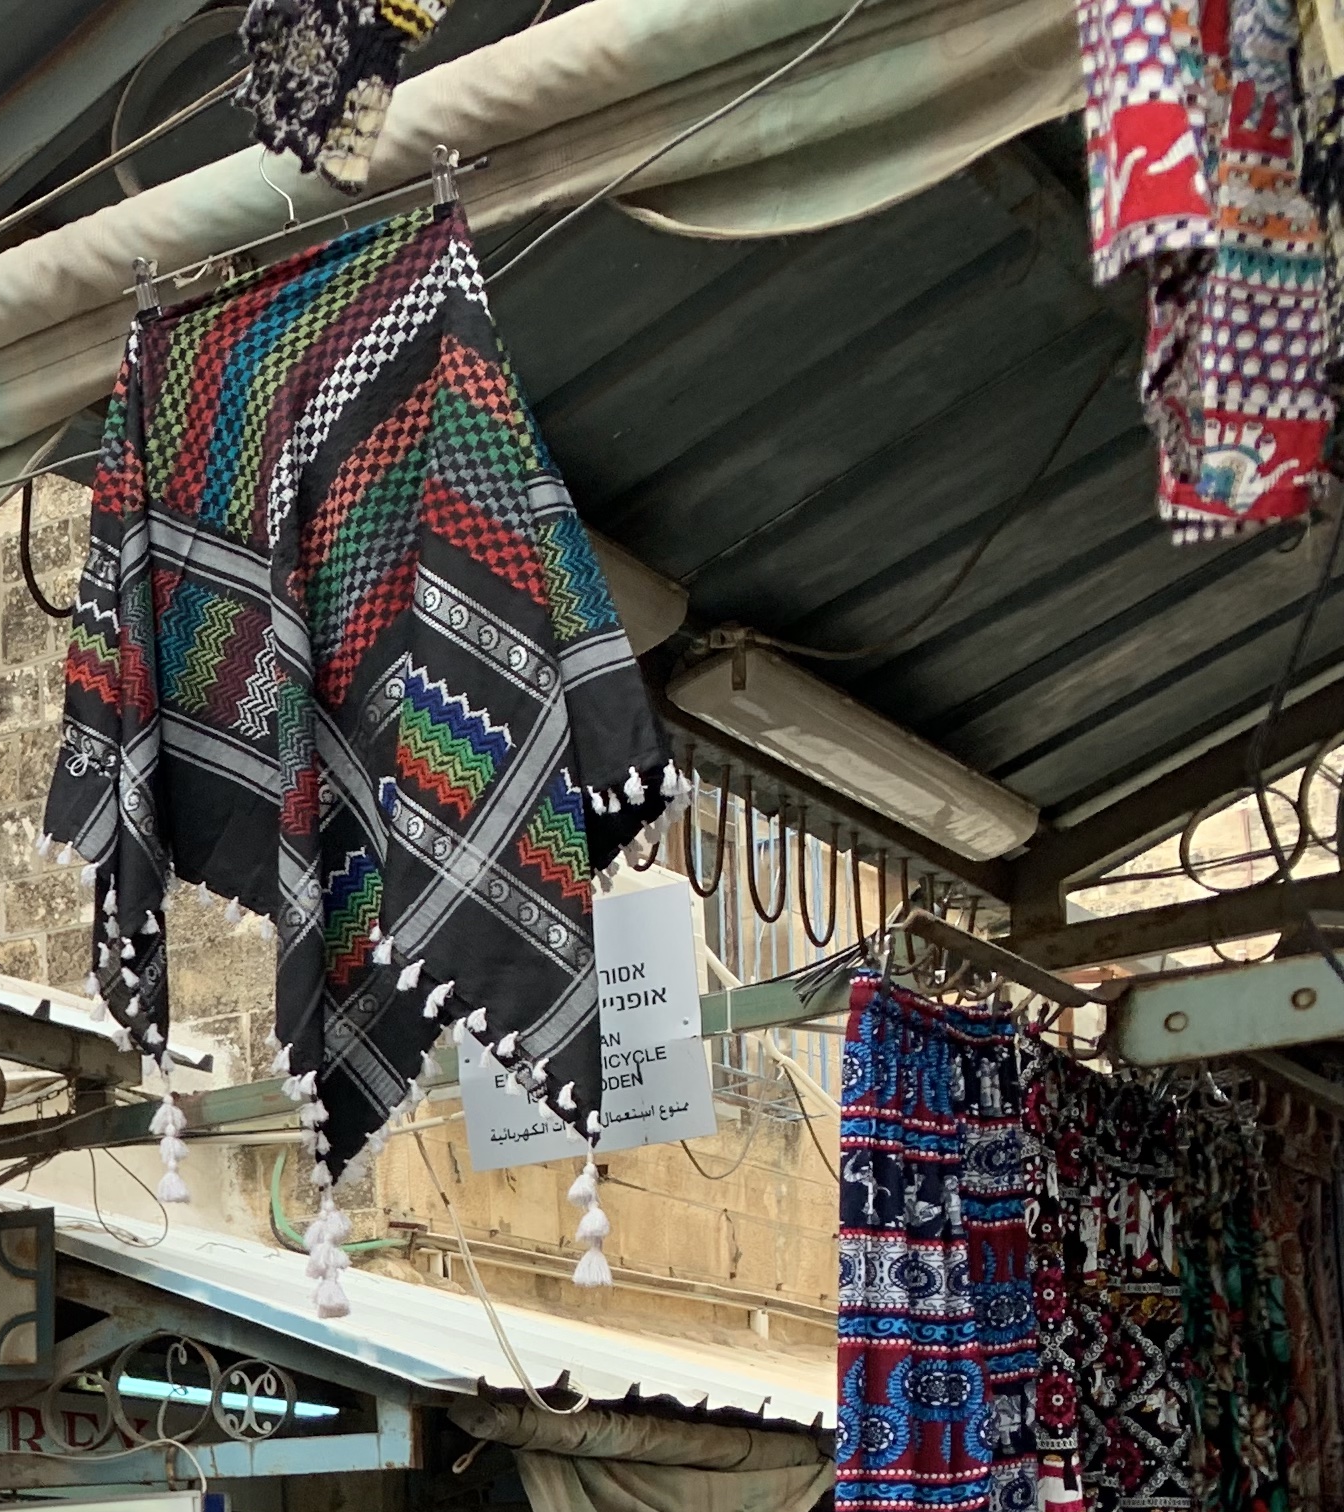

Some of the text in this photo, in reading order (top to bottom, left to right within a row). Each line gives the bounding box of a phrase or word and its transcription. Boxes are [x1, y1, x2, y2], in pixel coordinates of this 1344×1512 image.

[599, 962, 646, 985] אסור
[602, 986, 667, 1012] אופניי
[602, 1046, 667, 1070] ICYCLE
